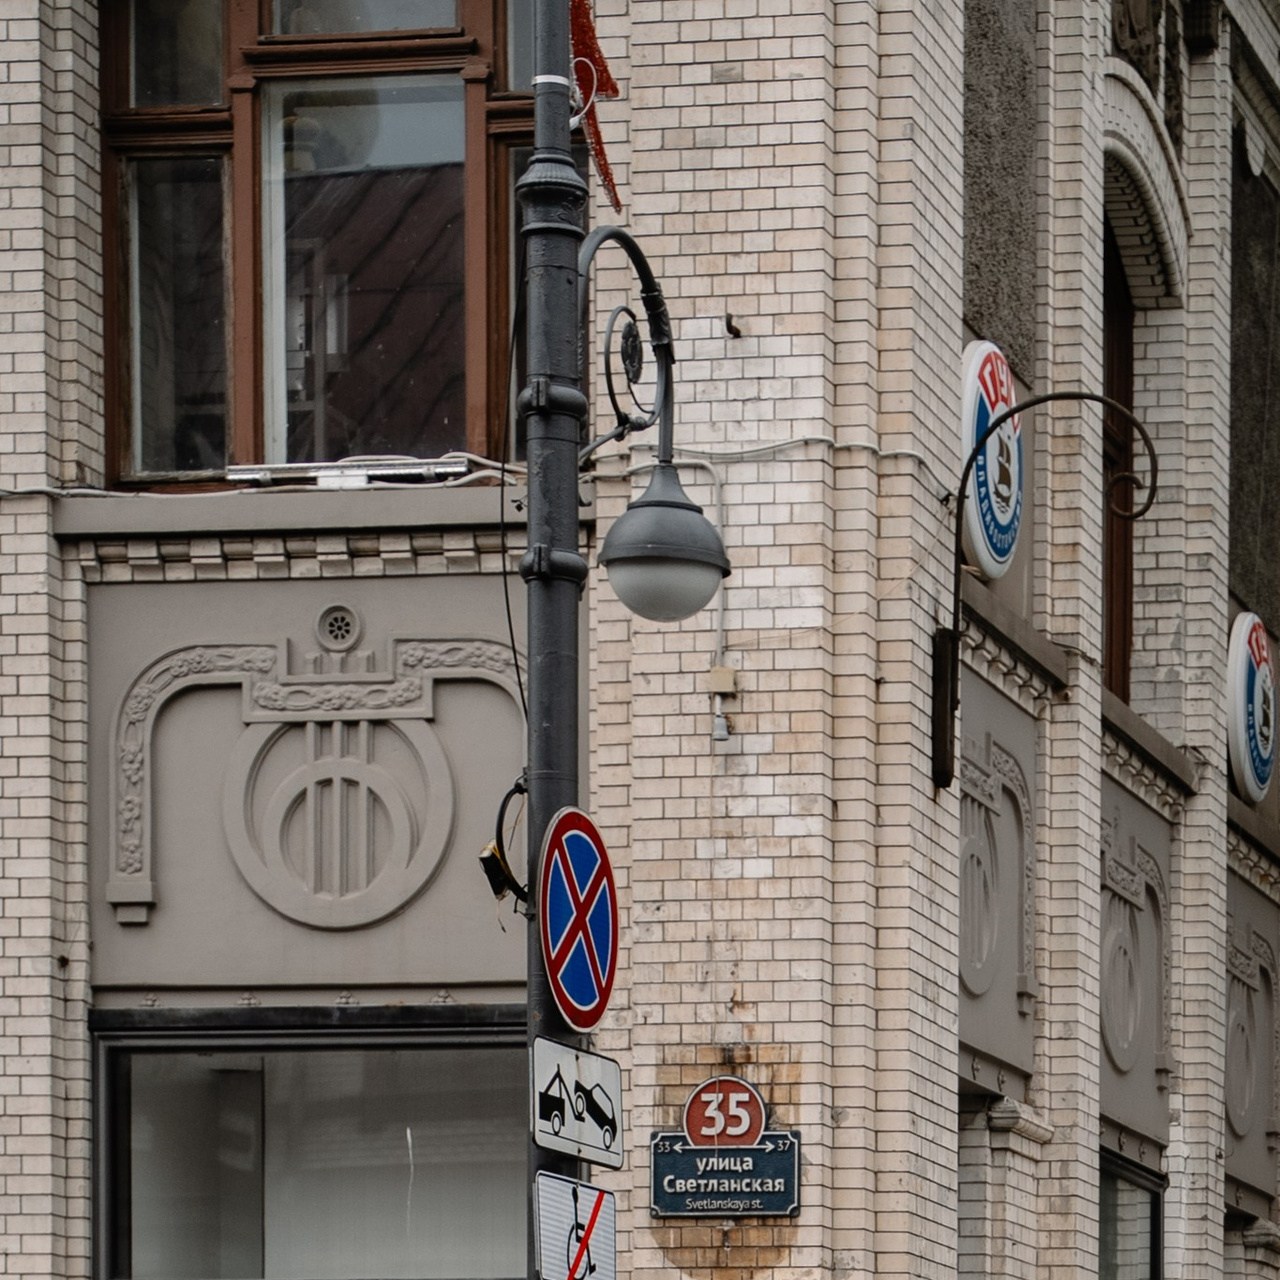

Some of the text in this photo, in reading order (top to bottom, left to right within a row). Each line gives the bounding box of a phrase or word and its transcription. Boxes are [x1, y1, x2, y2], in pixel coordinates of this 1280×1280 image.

[700, 1092, 751, 1136] 35
[657, 1141, 671, 1153] 33
[776, 1140, 790, 1151] 37
[696, 1156, 753, 1174] улица
[663, 1175, 785, 1192] Светланская
[686, 1198, 763, 1211] Svetlanskaya st.
